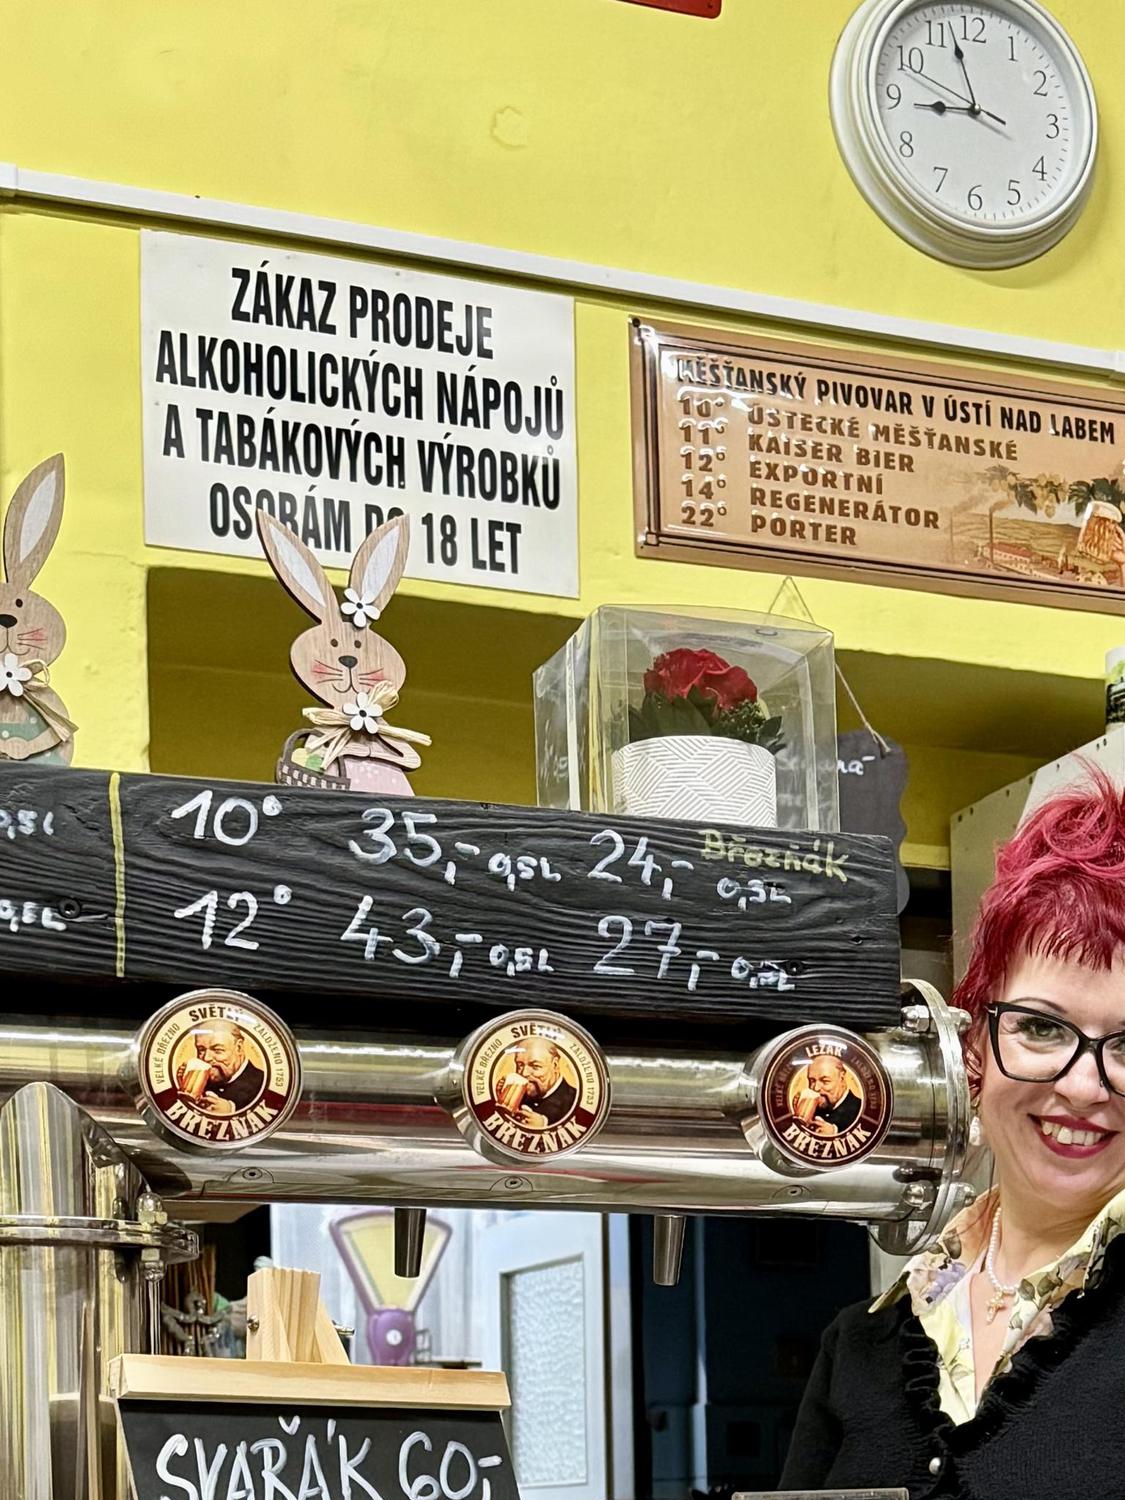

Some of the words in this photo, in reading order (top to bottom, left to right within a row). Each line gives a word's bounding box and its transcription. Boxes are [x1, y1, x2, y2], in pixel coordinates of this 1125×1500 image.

[924, 19, 949, 48] 11
[960, 16, 987, 44] 12
[897, 46, 925, 76] 10
[1008, 36, 1018, 62] 1
[886, 84, 902, 110] 9
[1032, 70, 1049, 98] 2
[1045, 113, 1060, 140] 3
[899, 131, 915, 159] 8
[932, 166, 949, 194] 7
[1032, 156, 1049, 183] 4
[966, 184, 984, 212] 6
[1006, 179, 1022, 207] 5
[231, 261, 336, 336] ZÁKAZ
[349, 285, 494, 359] PRODEJE
[156, 329, 423, 421] ALKOHOLICKÝCH
[436, 366, 564, 441] NÁPOJŮ
[676, 357, 808, 398] MĚŠŤANSKÝ
[817, 379, 913, 417] PIVOVAR
[921, 394, 934, 418] V
[943, 393, 992, 427] ÚSTÍ
[1000, 407, 1043, 434] NAD
[1049, 414, 1116, 445] LABEM
[747, 402, 861, 439] ÚSTECKÉ
[870, 423, 1019, 461] MĚŠŤANSKÉ
[162, 404, 186, 458] A
[195, 407, 405, 489] TABÁKOVÝCH
[417, 433, 561, 510] VÝROBKŮ
[748, 427, 843, 463] KAISER
[855, 445, 915, 473] BIER
[680, 446, 726, 473] 12°
[749, 454, 884, 496] EXPORTNÍ
[681, 473, 727, 500] 14°
[750, 485, 940, 530] REGENERÁTOR
[365, 503, 404, 537] D
[421, 512, 457, 566] 18
[470, 517, 522, 574] LET
[681, 501, 727, 528] 22°
[750, 512, 857, 546] PORTER
[348, 808, 480, 885] 35,-
[587, 829, 694, 900] 24,-
[341, 895, 484, 977] 43,-
[593, 915, 720, 991] 27,-
[188, 1003, 244, 1023] SVĚT
[156, 1022, 181, 1056] BŘEZNO
[253, 1022, 284, 1066] ZALOŽENO
[479, 1038, 503, 1068] BŘEZNO
[152, 1057, 165, 1085] VELKÉ
[474, 1069, 486, 1097] VELKÉ
[164, 1098, 279, 1142] BŘEZŇÁK
[483, 1110, 588, 1153] BŘEZŇÁK
[782, 1122, 872, 1159] BŘEZŇÁK
